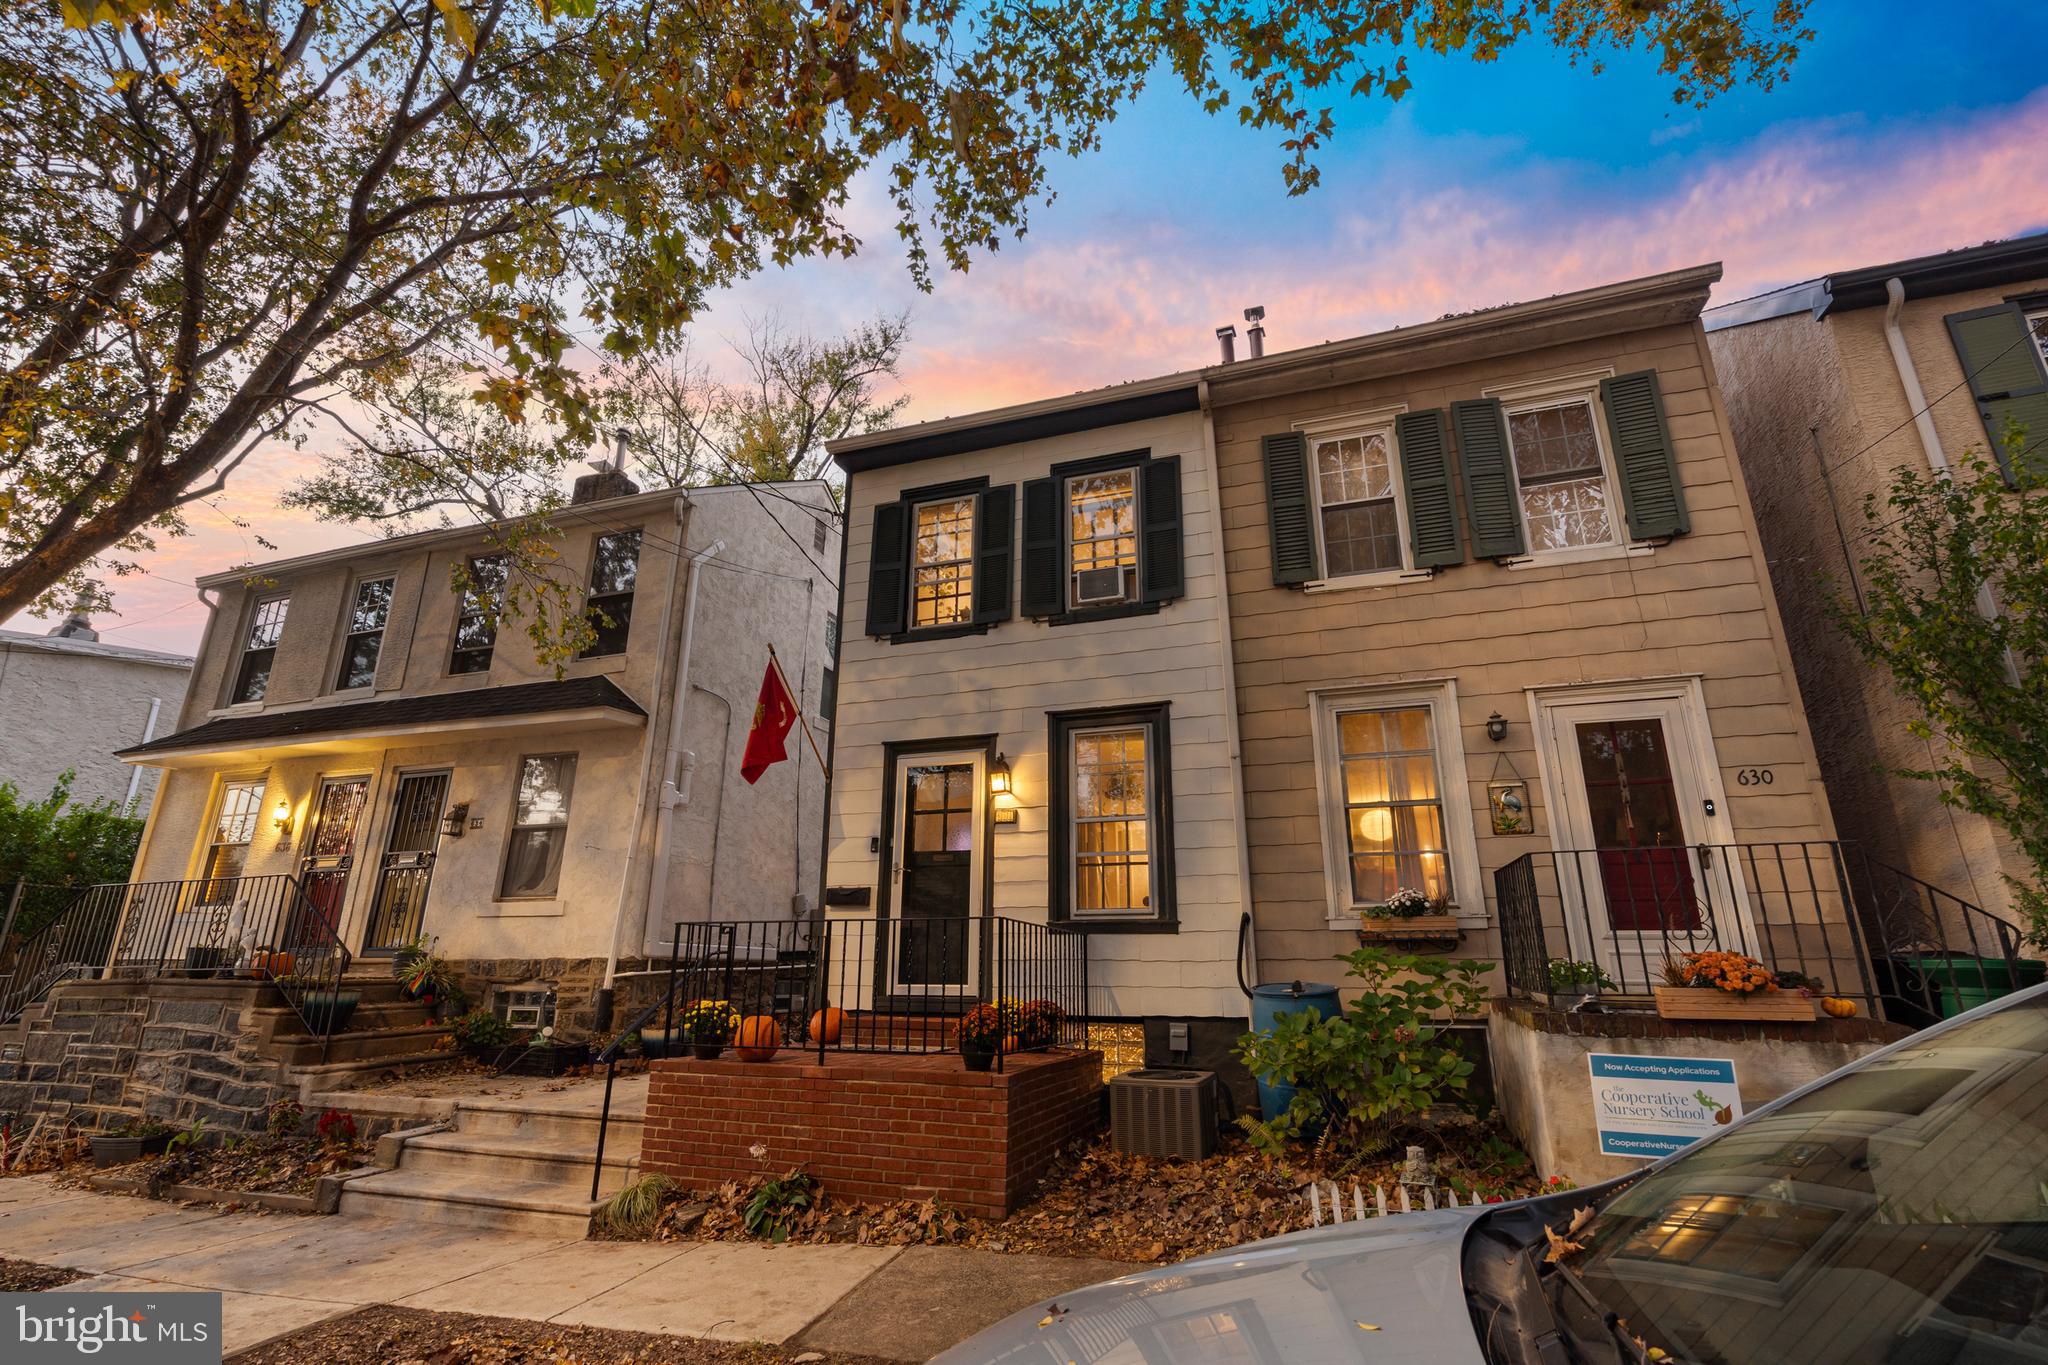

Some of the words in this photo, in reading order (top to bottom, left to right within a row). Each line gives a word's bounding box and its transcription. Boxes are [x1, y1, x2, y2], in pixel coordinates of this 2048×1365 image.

[1737, 769, 1773, 786] 630
[1604, 1063, 1623, 1071] Now
[1624, 1064, 1667, 1075] Accepting
[1668, 1066, 1720, 1076] Applications
[1601, 1089, 1689, 1106] Cooperative
[1603, 1102, 1657, 1119] Nursery
[1660, 1105, 1705, 1120] School
